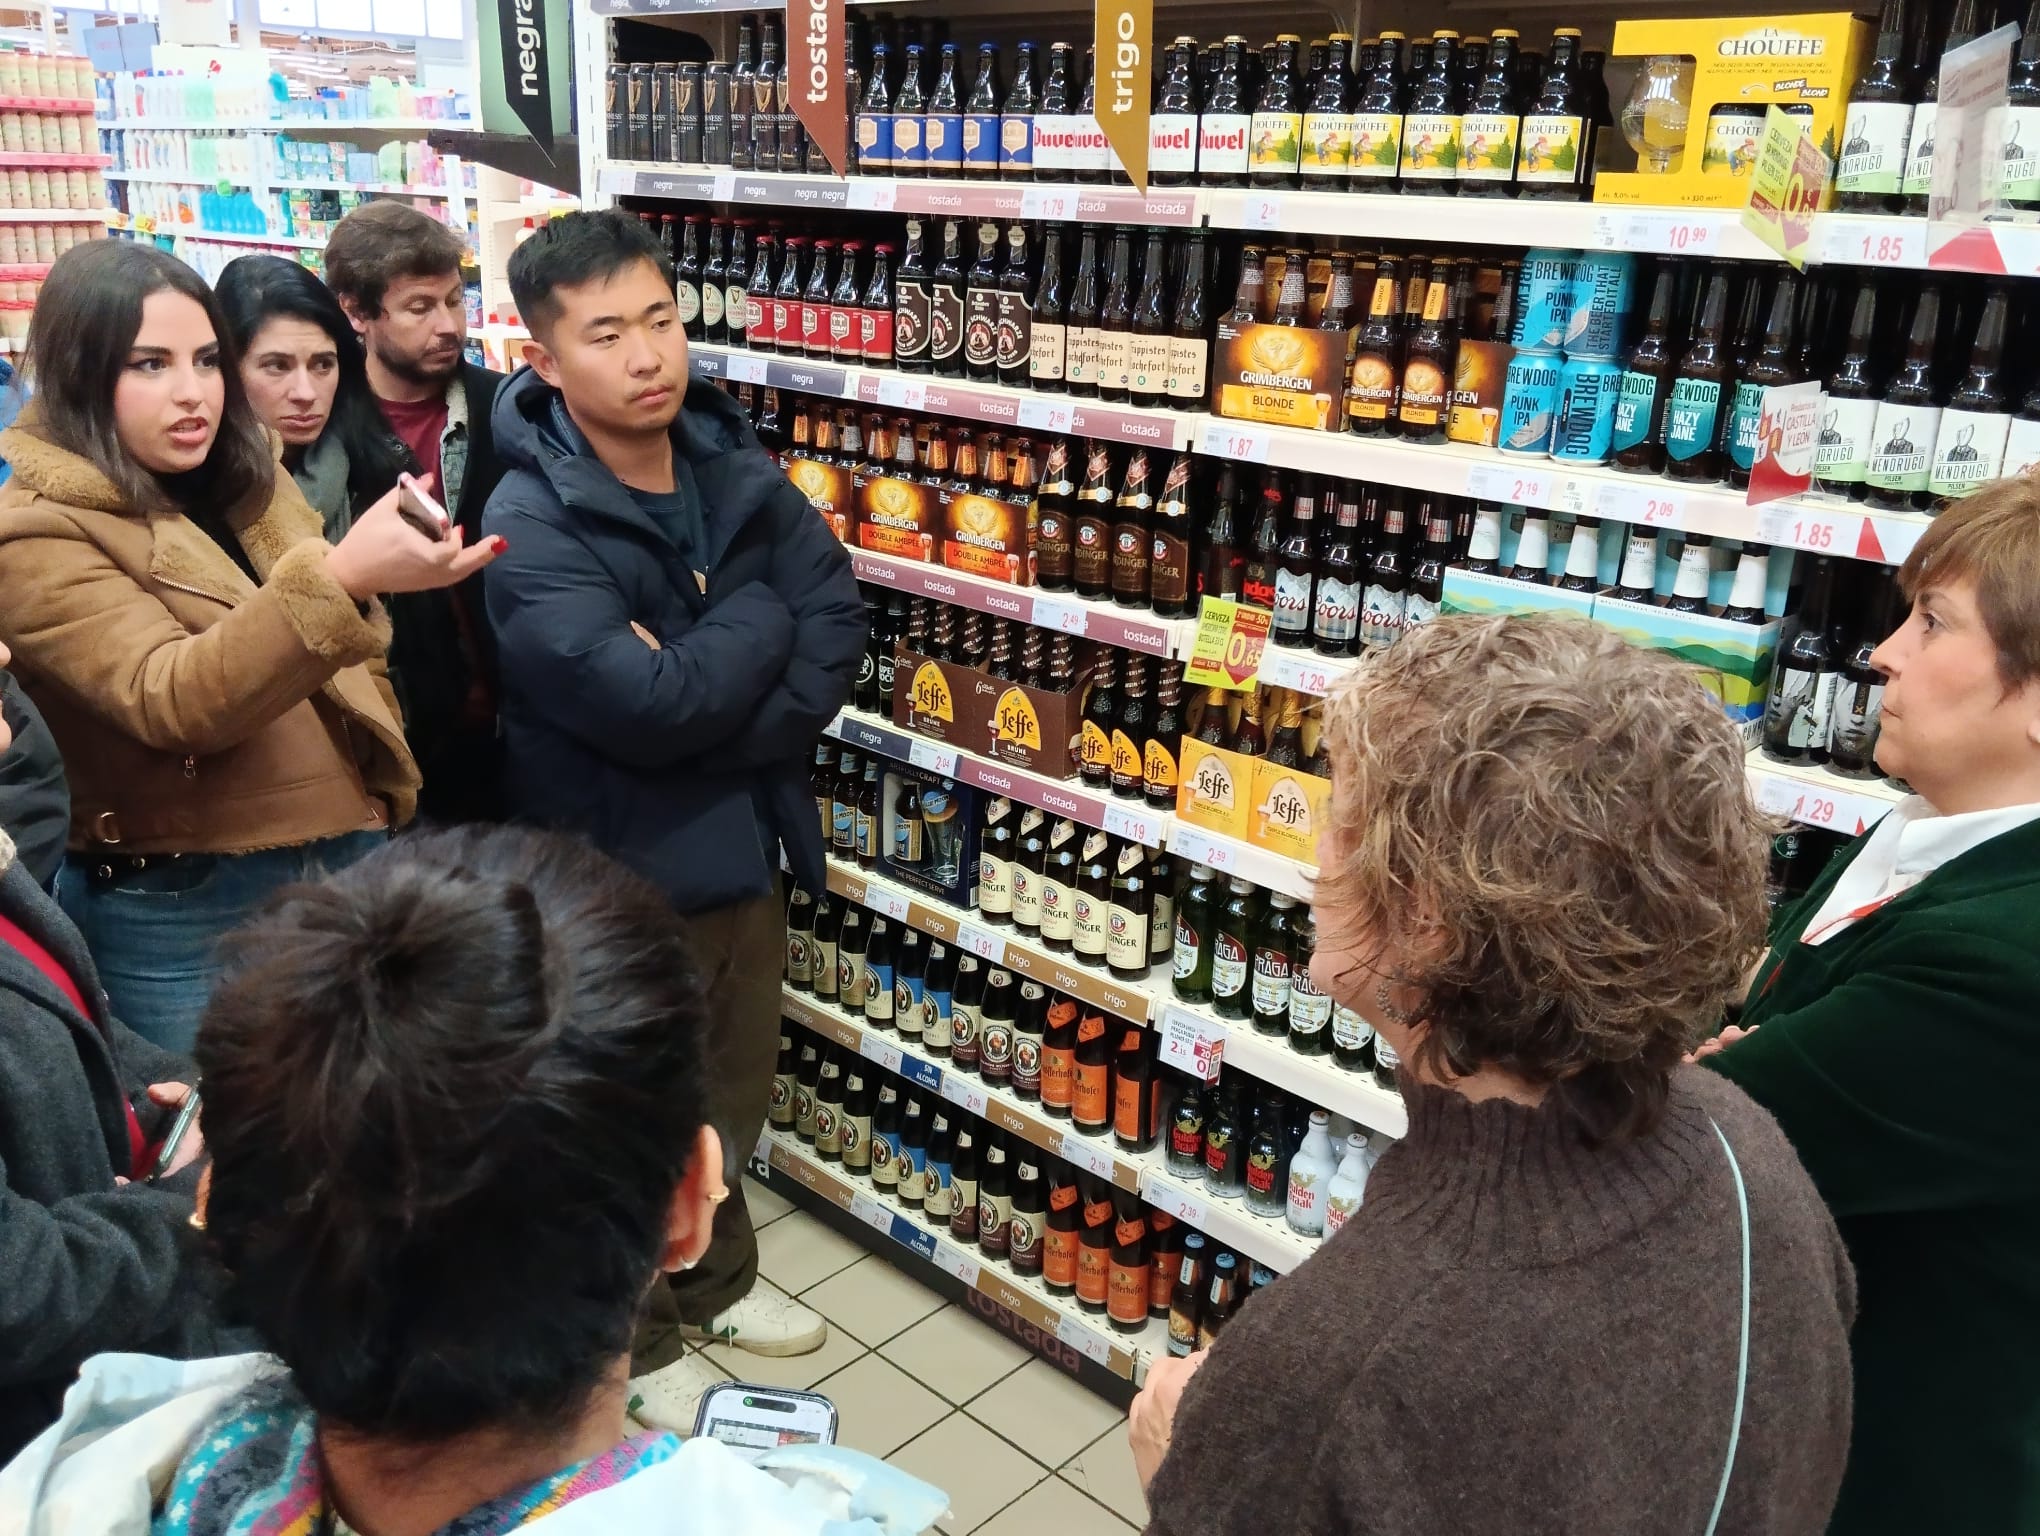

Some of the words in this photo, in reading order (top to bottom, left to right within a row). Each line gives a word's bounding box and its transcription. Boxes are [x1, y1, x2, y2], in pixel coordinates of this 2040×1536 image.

[1718, 39, 1823, 56] CHOUFFE
[1112, 12, 1140, 115] trigo
[1775, 80, 1805, 91] BLONDE
[1801, 89, 1829, 97] BLOND
[1839, 155, 1882, 175] ENDRUGO
[745, 186, 766, 196] negra
[795, 188, 817, 200] negra
[822, 191, 845, 201] negra
[928, 194, 962, 206] tostada
[1042, 200, 1064, 216] 1.79
[1078, 201, 1106, 213] stada
[1146, 202, 1186, 215] tostada
[1670, 226, 1707, 249] 10.99
[1862, 236, 1903, 260] 1.85
[698, 358, 719, 370] negra
[791, 373, 814, 385] negra
[1240, 370, 1312, 390] GRIMBERGEN
[925, 395, 947, 407] stada
[979, 402, 1014, 416] tostada
[1252, 395, 1294, 410] BLONDE
[1511, 395, 1539, 411] PUNK
[1514, 411, 1530, 426] IPA
[1565, 373, 1600, 455] BREWDOG
[1673, 410, 1700, 427] HAZY
[1786, 413, 1816, 430] CASTILLA
[1121, 421, 1160, 438] tostada
[1671, 425, 1697, 441] JANE
[1228, 437, 1252, 457] 1.87
[1512, 480, 1538, 500] 2.19
[1645, 500, 1673, 520] 2.09
[871, 513, 918, 531] GRIMBERGEN
[868, 530, 893, 543] DOUBLE
[955, 530, 1005, 551] GRIMBERGEN
[1794, 521, 1833, 548] 1.85
[953, 550, 977, 563] DOUBLE
[866, 565, 895, 580] tostada
[924, 579, 956, 596] tostada
[986, 595, 1020, 612] tostada
[1275, 592, 1307, 612] oors
[1204, 611, 1230, 623] CERVEZA
[1123, 628, 1163, 647] tostada
[1300, 672, 1325, 690] 1.29
[917, 681, 946, 711] Leffe
[1001, 707, 1034, 738] Leffe
[859, 730, 882, 745] negra
[978, 770, 1011, 790] tostada
[1198, 770, 1230, 799] Leffe
[1042, 792, 1077, 812] tostada
[1273, 794, 1306, 824] Leffe
[1795, 795, 1834, 822] 1.29
[1124, 821, 1145, 840] 1.19
[1207, 848, 1226, 864] 2.59
[846, 883, 864, 898] trigo
[925, 917, 945, 933] trigo
[975, 937, 992, 956] 1.91
[1008, 952, 1030, 968] trigo
[1254, 954, 1288, 977] PRAGA
[1056, 971, 1077, 988] trigo
[1104, 991, 1127, 1008] trigo
[837, 1029, 855, 1045] trigo
[923, 1063, 934, 1074] SIN
[916, 1071, 938, 1088] ALCOHOL
[1003, 1113, 1024, 1131] trigo
[800, 1167, 816, 1182] trigo
[1180, 1202, 1197, 1218] 2.39
[918, 1232, 929, 1242] SIN
[1000, 1288, 1021, 1308] trigo
